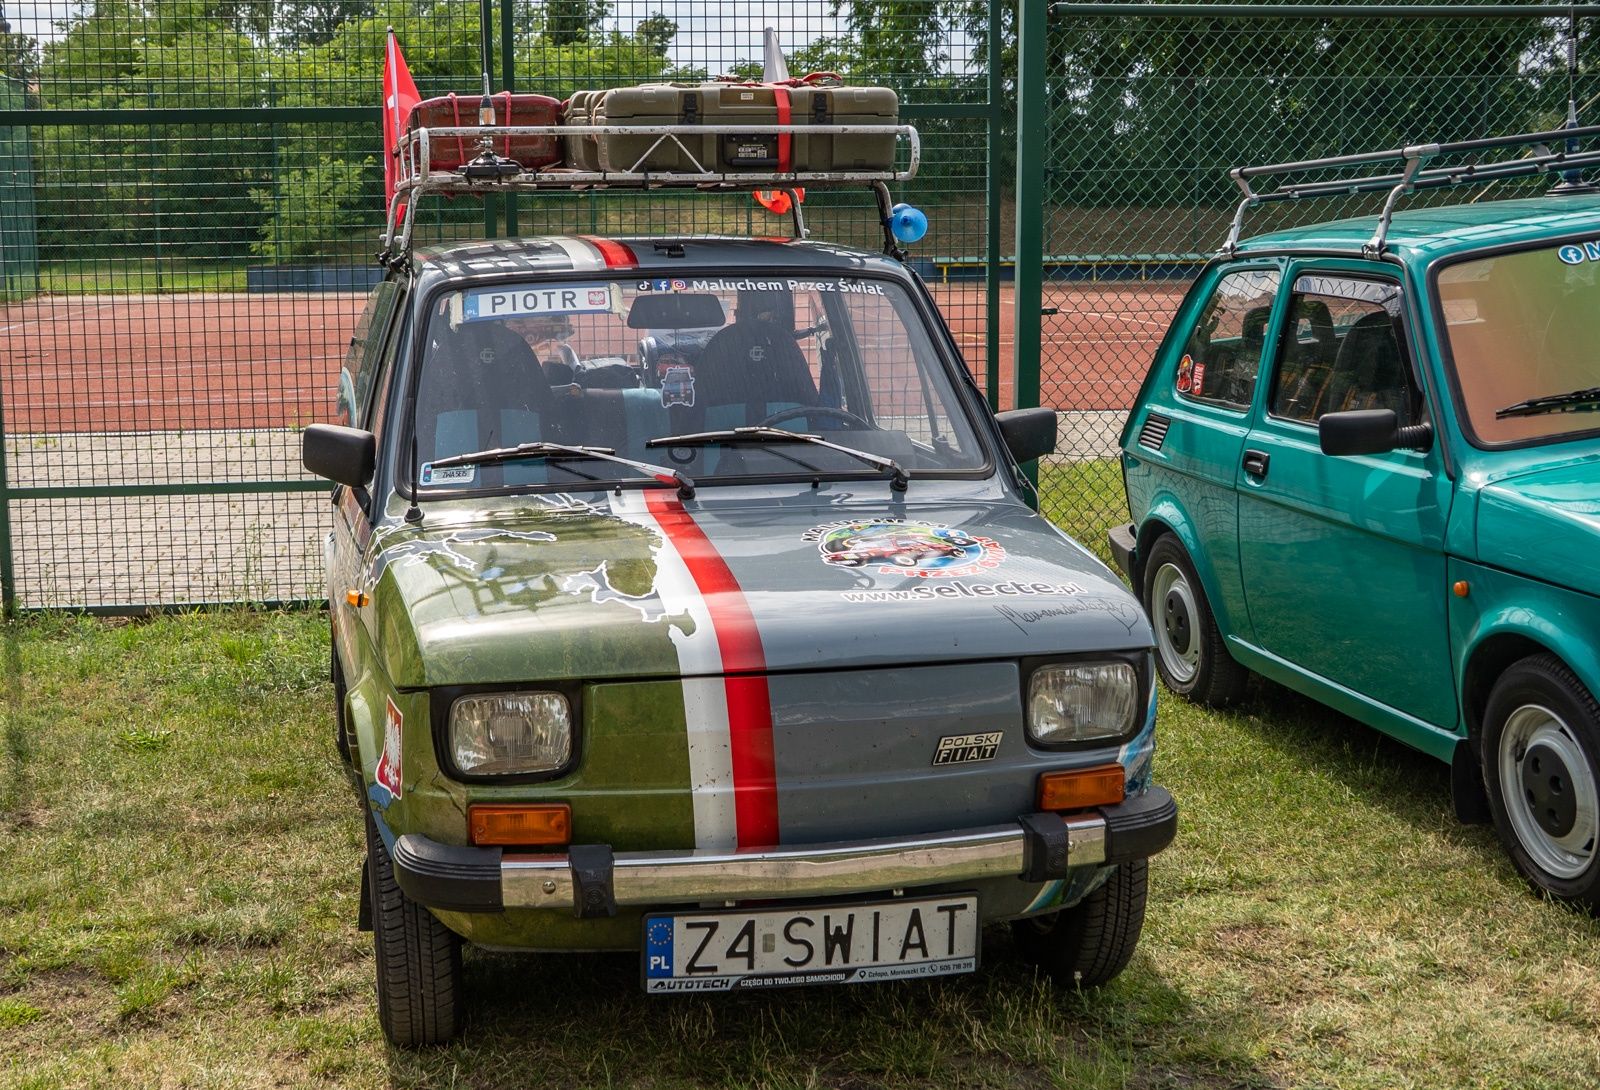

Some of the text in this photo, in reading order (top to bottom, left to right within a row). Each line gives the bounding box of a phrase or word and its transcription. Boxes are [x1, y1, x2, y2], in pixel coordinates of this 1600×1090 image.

[692, 277, 884, 296] Maluchem Przez Świat
[491, 290, 577, 313] PIOTR
[843, 581, 1088, 602] www.selecte.pl
[942, 734, 1000, 748] POLSKI
[938, 745, 996, 762] FIAT
[685, 903, 968, 974] Z4 SWIAT
[649, 955, 671, 971] PL
[652, 978, 731, 992] AUTOTECH
[740, 977, 763, 988] CZĘŚCI
[774, 975, 805, 985] TWOJEGO
[805, 973, 846, 983] SAMOCHODU
